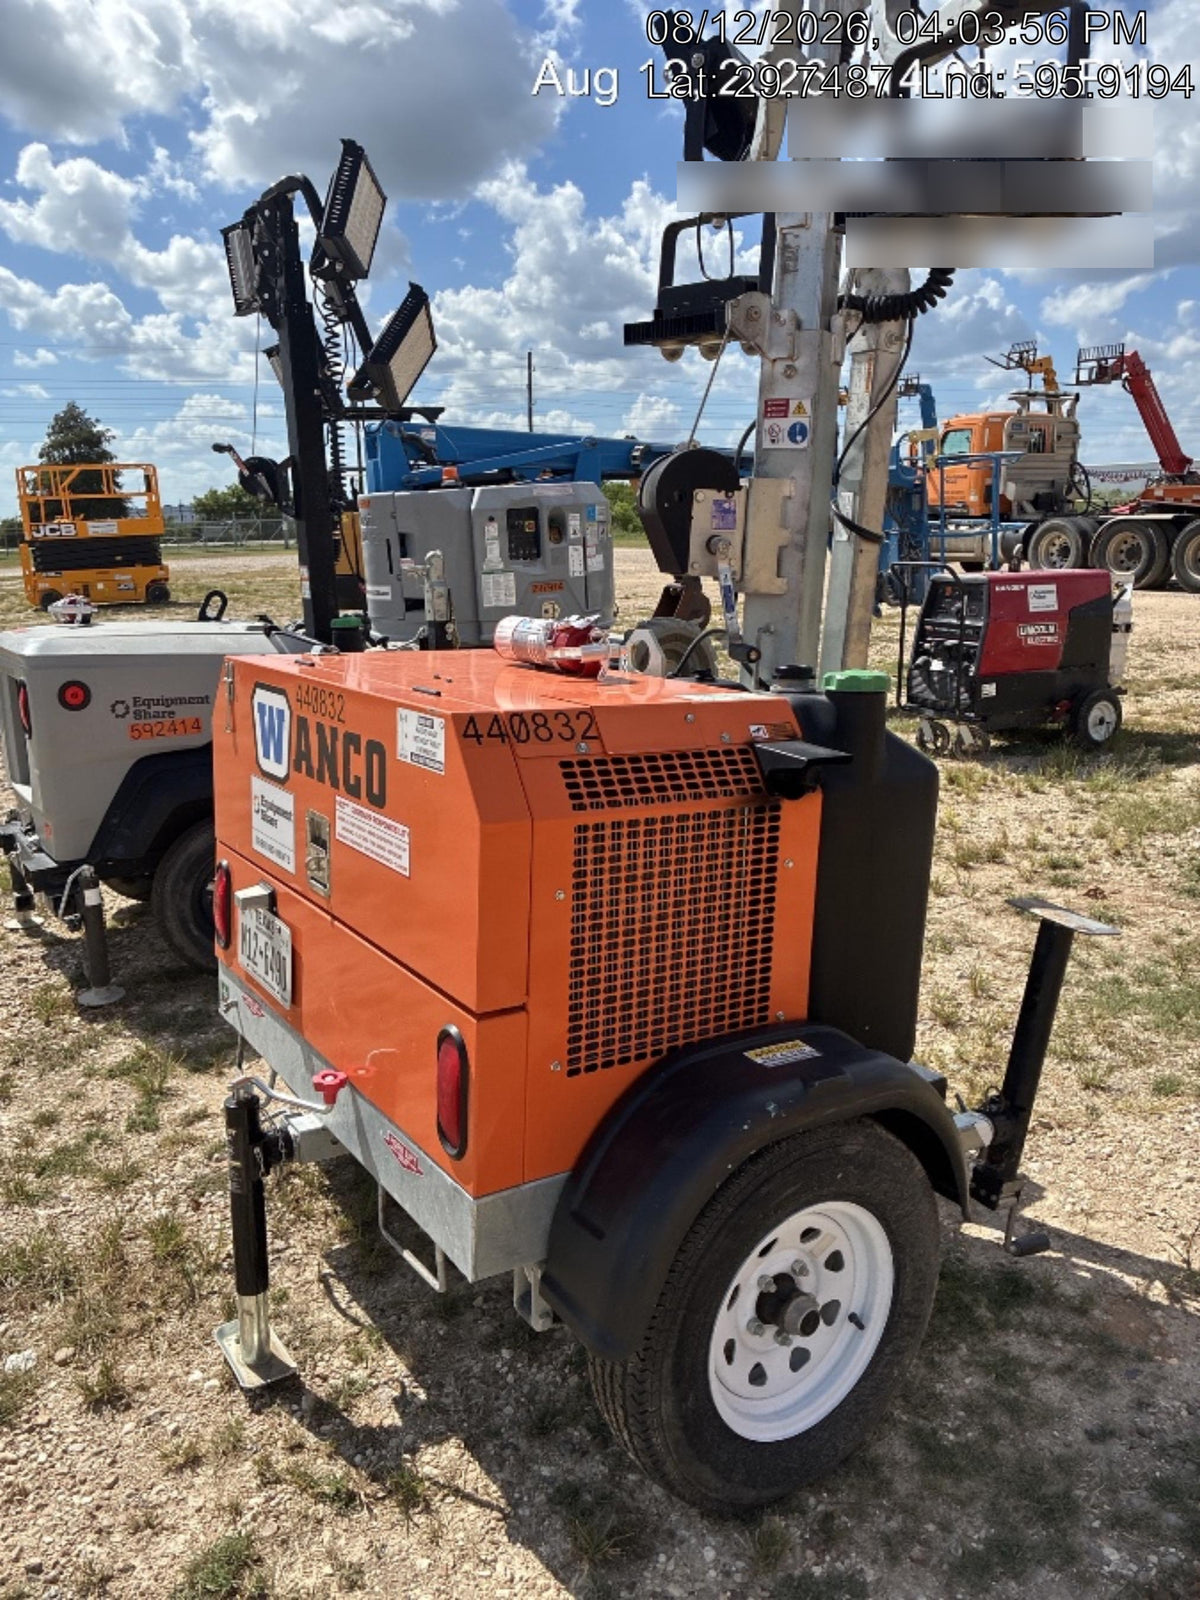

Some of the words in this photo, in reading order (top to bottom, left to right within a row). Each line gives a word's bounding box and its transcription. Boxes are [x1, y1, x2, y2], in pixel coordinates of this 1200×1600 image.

[32, 523, 77, 537] JCB
[132, 694, 211, 709] Equipment
[296, 683, 346, 724] 440832
[132, 709, 176, 720] Share
[130, 718, 202, 740] 592414
[462, 710, 600, 745] 440832
[256, 700, 387, 810] WANCO
